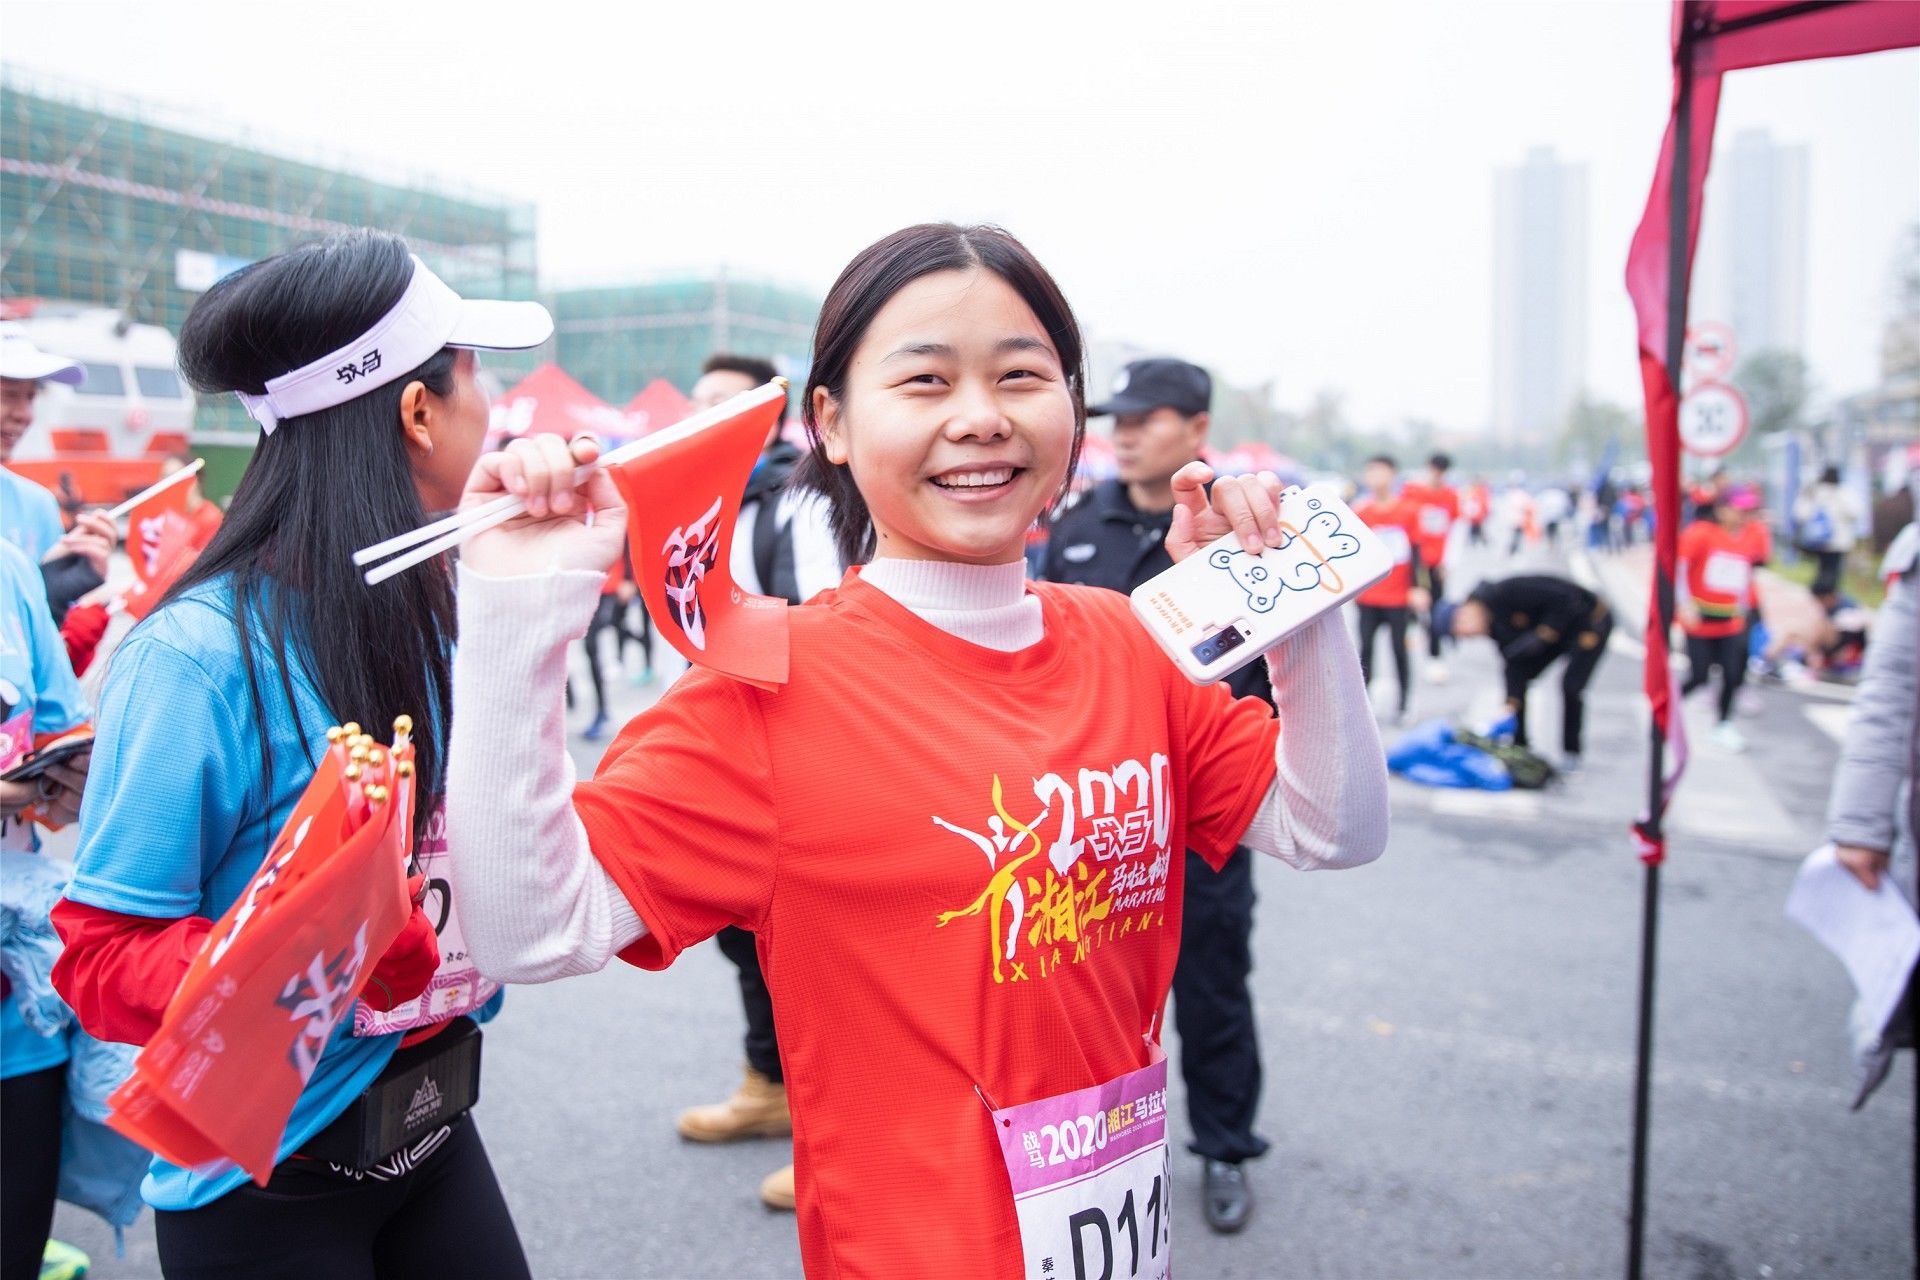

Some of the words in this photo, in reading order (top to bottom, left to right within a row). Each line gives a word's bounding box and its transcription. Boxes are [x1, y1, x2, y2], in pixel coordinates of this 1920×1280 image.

[1032, 752, 1171, 876] 2020
[1024, 861, 1113, 948] 湘江
[1110, 885, 1166, 914] MARATHO
[1022, 1132, 1046, 1169] 战马
[1041, 1111, 1107, 1166] 2020
